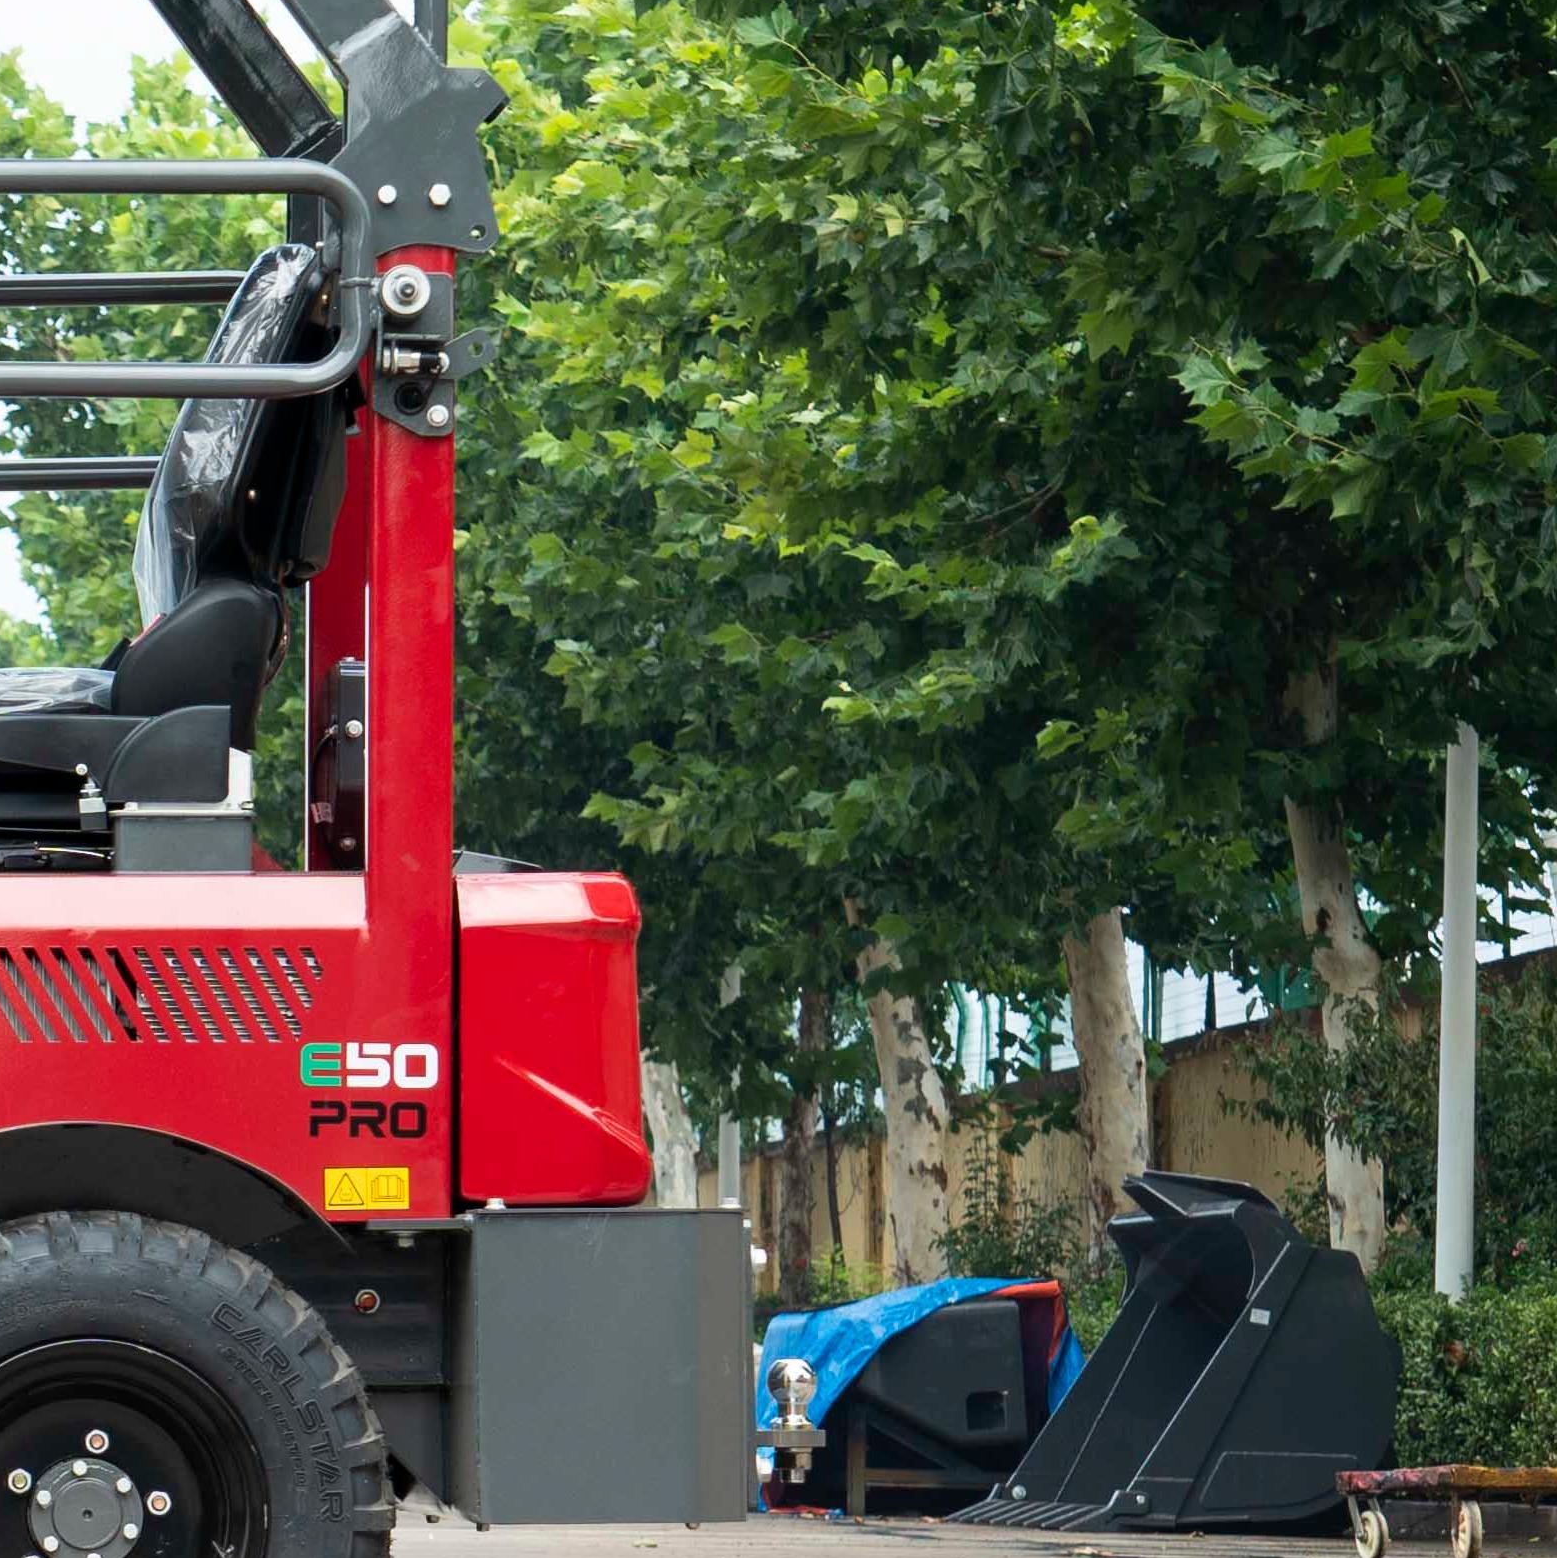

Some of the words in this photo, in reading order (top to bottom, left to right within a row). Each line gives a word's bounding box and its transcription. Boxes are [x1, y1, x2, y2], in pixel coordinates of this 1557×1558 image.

[300, 1042, 439, 1089] E50
[309, 1100, 427, 1139] PRO
[211, 1301, 346, 1525] CARLSTAR
